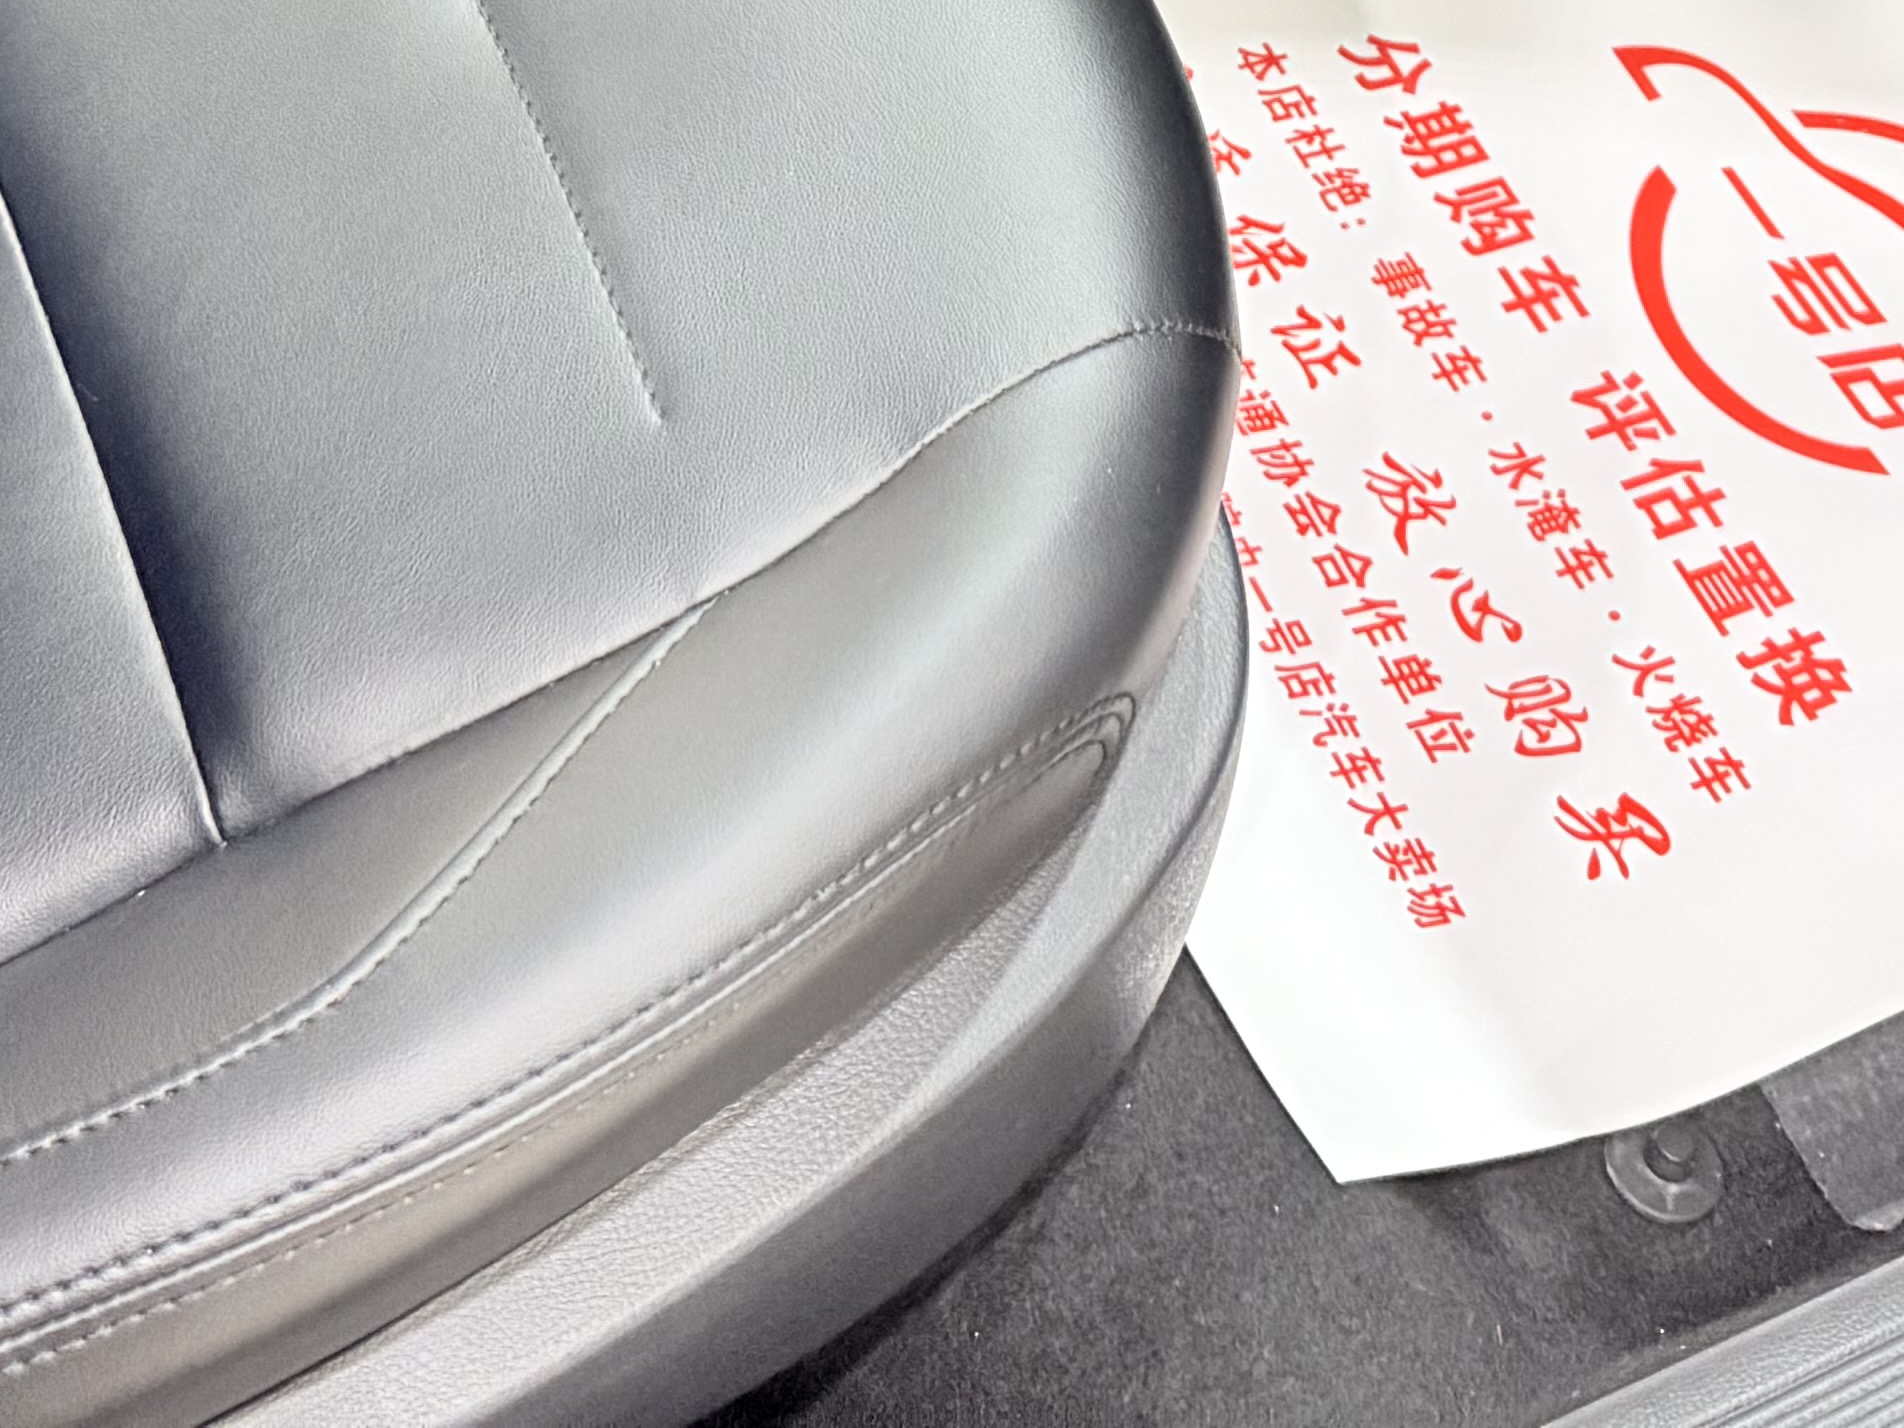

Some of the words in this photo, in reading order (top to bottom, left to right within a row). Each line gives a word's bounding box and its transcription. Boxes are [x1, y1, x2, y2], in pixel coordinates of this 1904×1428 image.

[1337, 33, 1591, 335] 分期购车
[1570, 370, 1853, 727] 评估置换
[1363, 452, 1672, 882] 放心购买
